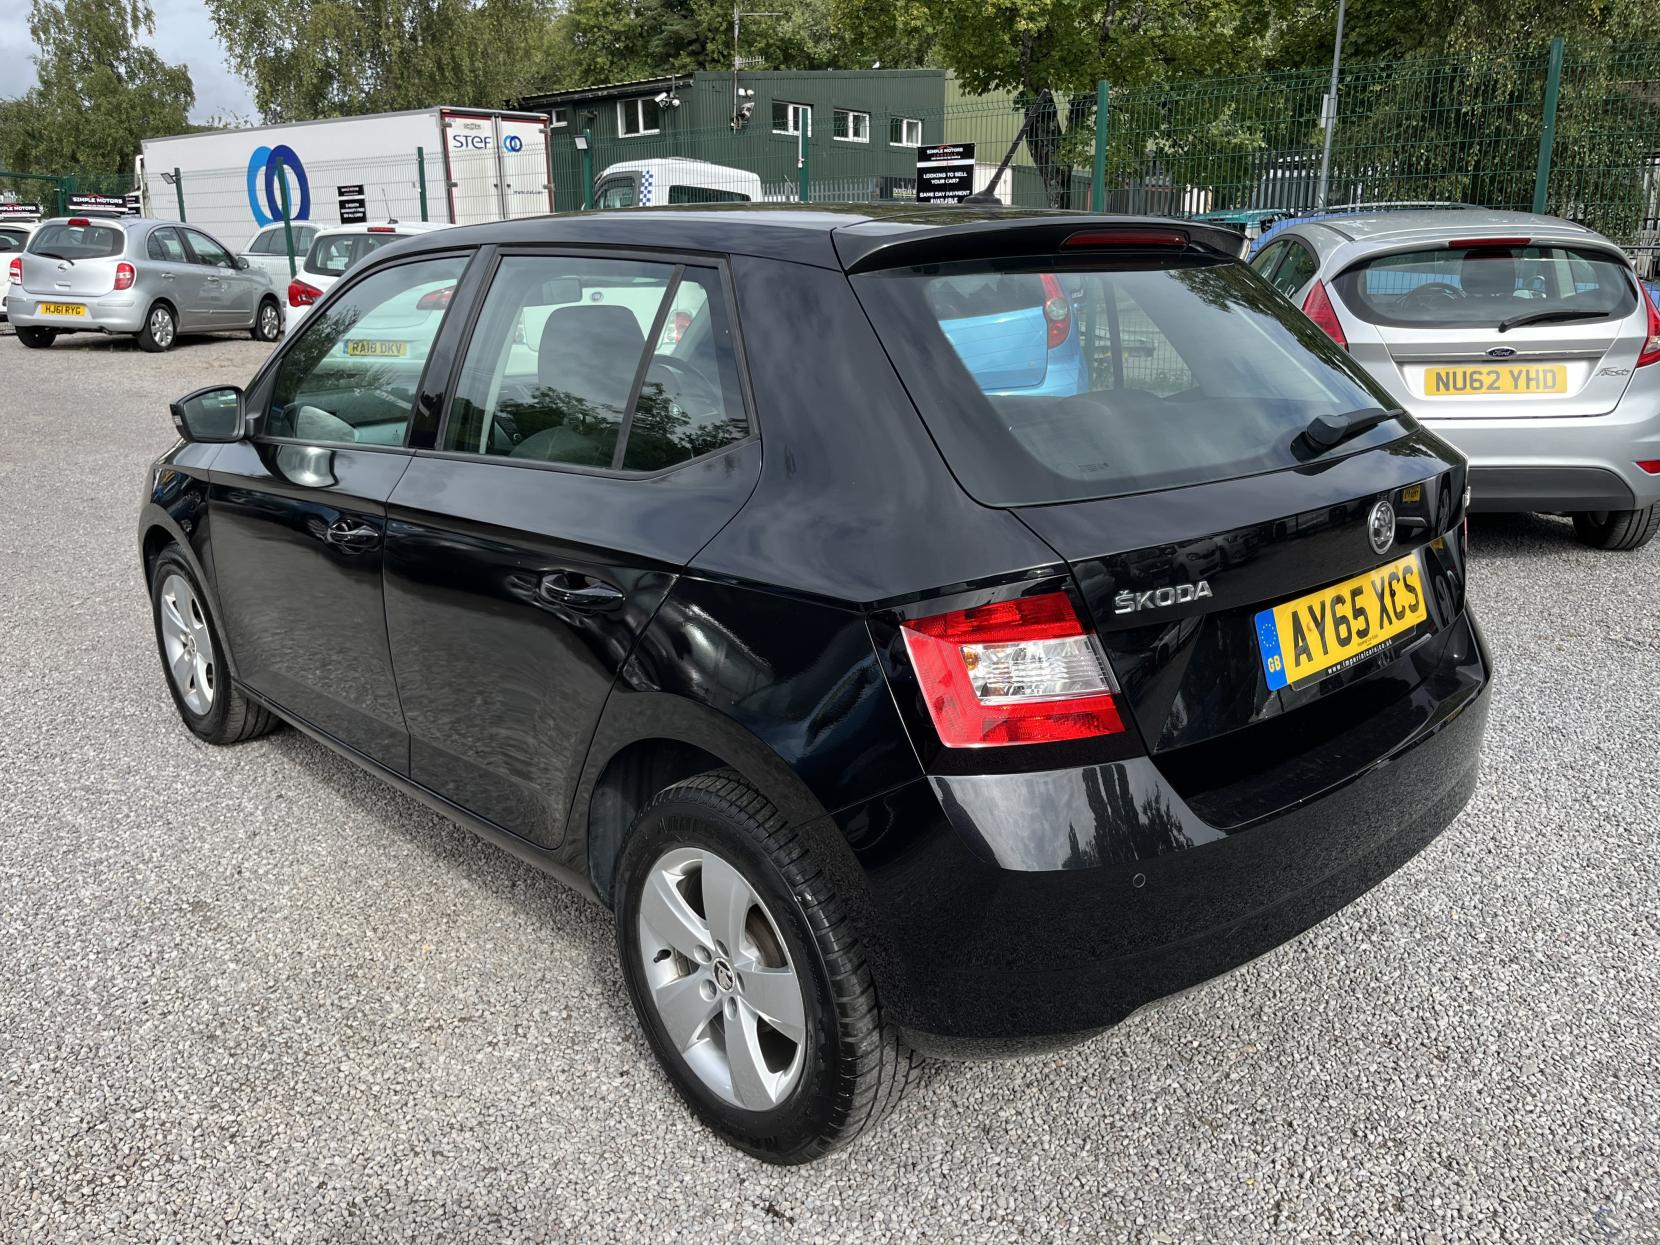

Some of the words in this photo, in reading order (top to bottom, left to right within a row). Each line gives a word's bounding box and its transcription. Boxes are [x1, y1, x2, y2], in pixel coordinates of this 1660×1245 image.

[45, 305, 63, 314] HJ61
[65, 306, 81, 315] RYG
[380, 343, 402, 354] DKV
[1435, 370, 1501, 392] NU62
[1509, 369, 1557, 390] YHD
[1291, 585, 1370, 669] AY65
[1370, 564, 1421, 631] XCS
[1267, 655, 1282, 673] GB
